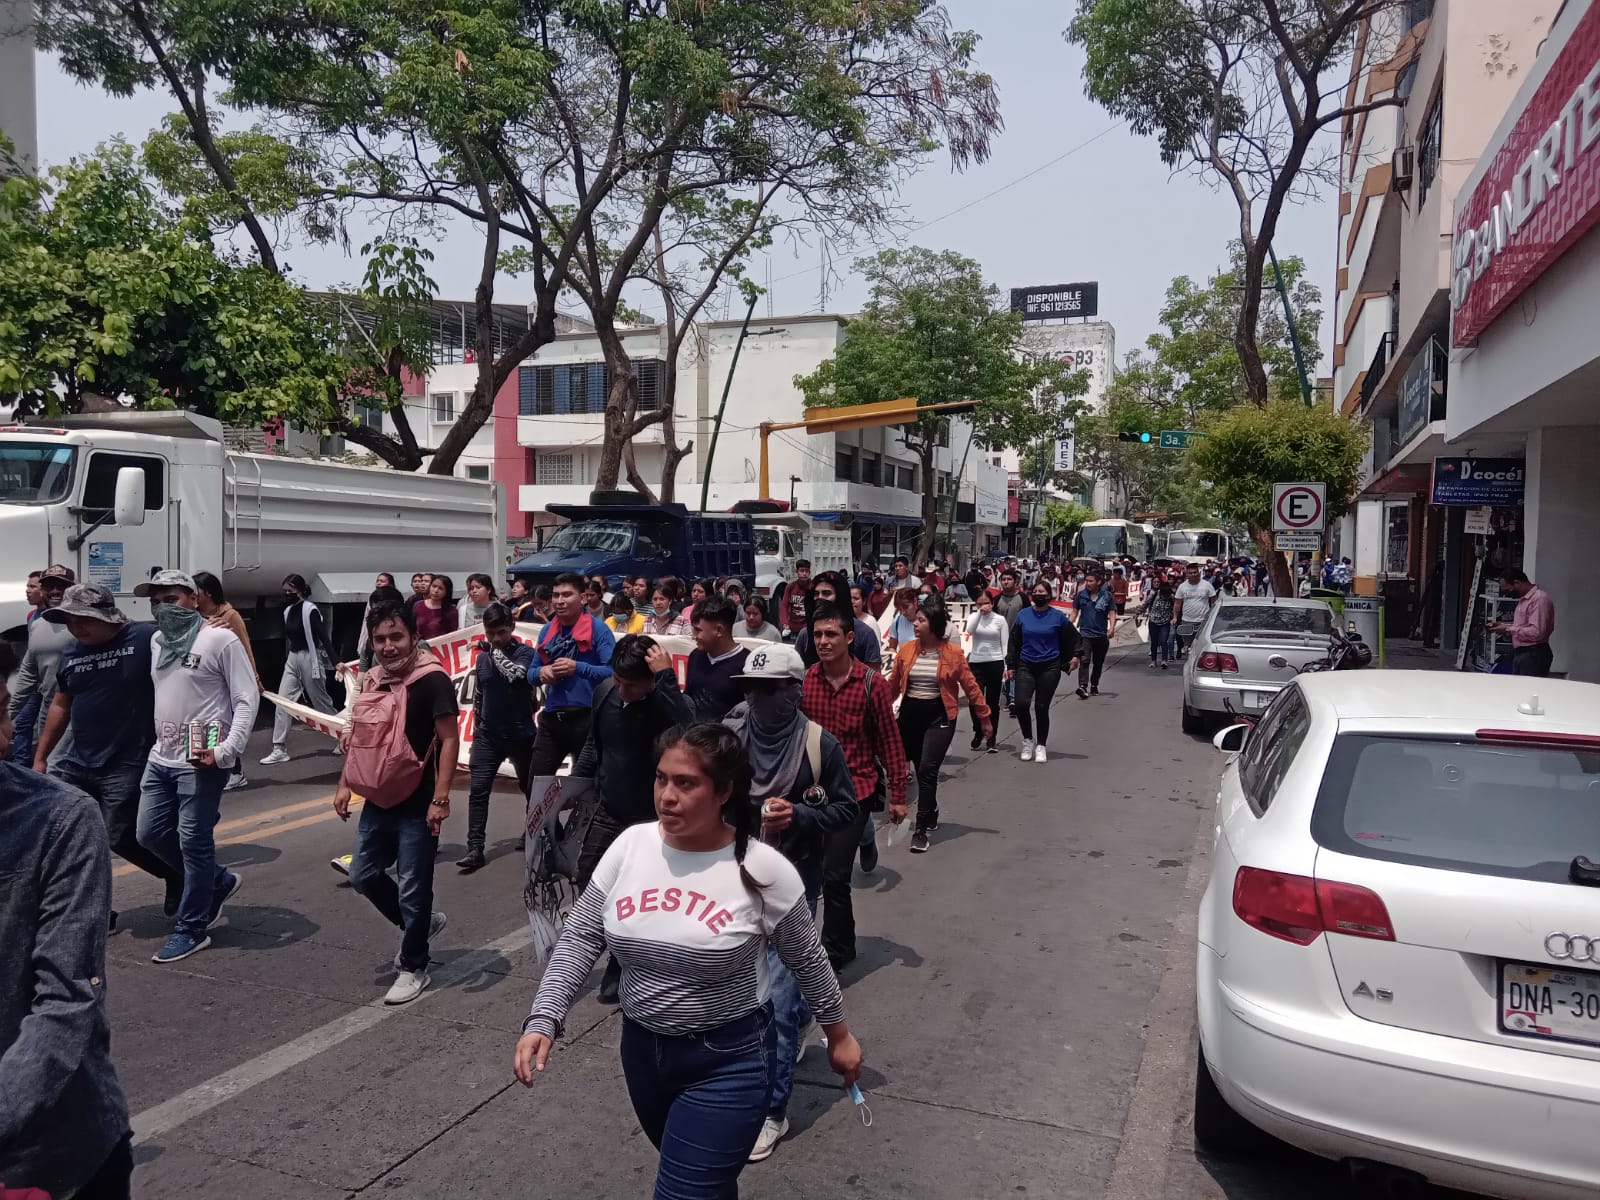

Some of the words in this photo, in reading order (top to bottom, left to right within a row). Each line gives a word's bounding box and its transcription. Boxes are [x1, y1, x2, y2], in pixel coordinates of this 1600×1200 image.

[1474, 60, 1600, 282] BANORTE
[1027, 291, 1082, 303] DISPONIBLE
[1289, 495, 1309, 519] E
[74, 663, 93, 673] NYC
[752, 653, 767, 667] 83
[616, 887, 734, 935] BESTIE
[1510, 982, 1600, 1020] DNA-30
